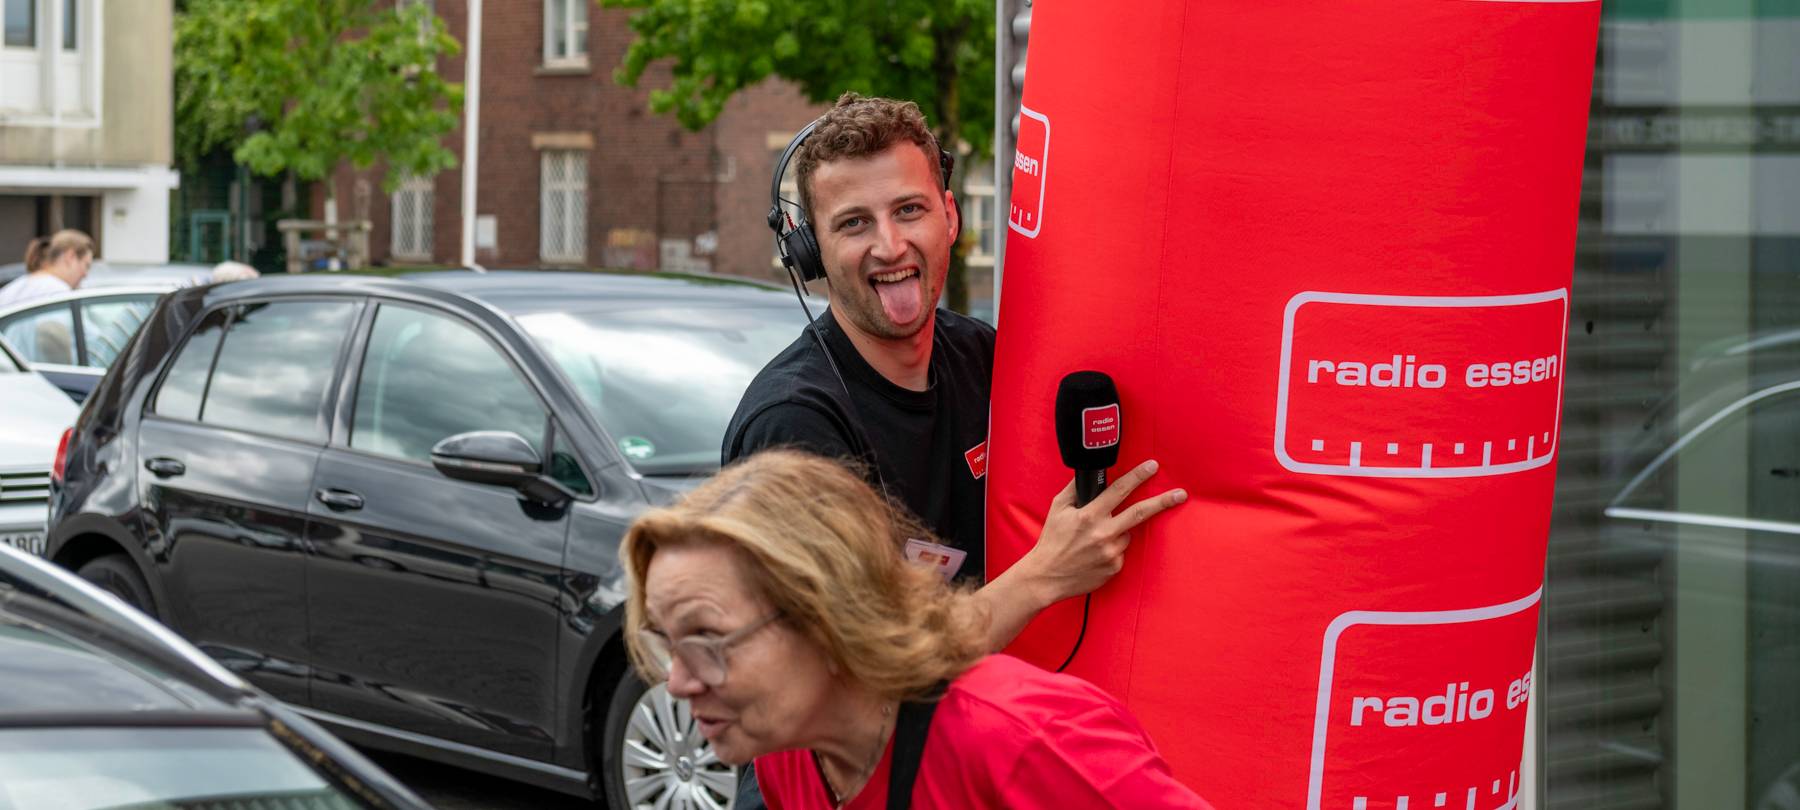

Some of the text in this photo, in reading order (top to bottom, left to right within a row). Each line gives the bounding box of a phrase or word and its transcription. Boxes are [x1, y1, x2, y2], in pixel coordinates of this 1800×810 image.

[1307, 355, 1558, 388] radio essen
[1092, 417, 1114, 426] radio
[1350, 682, 1495, 727] radio
